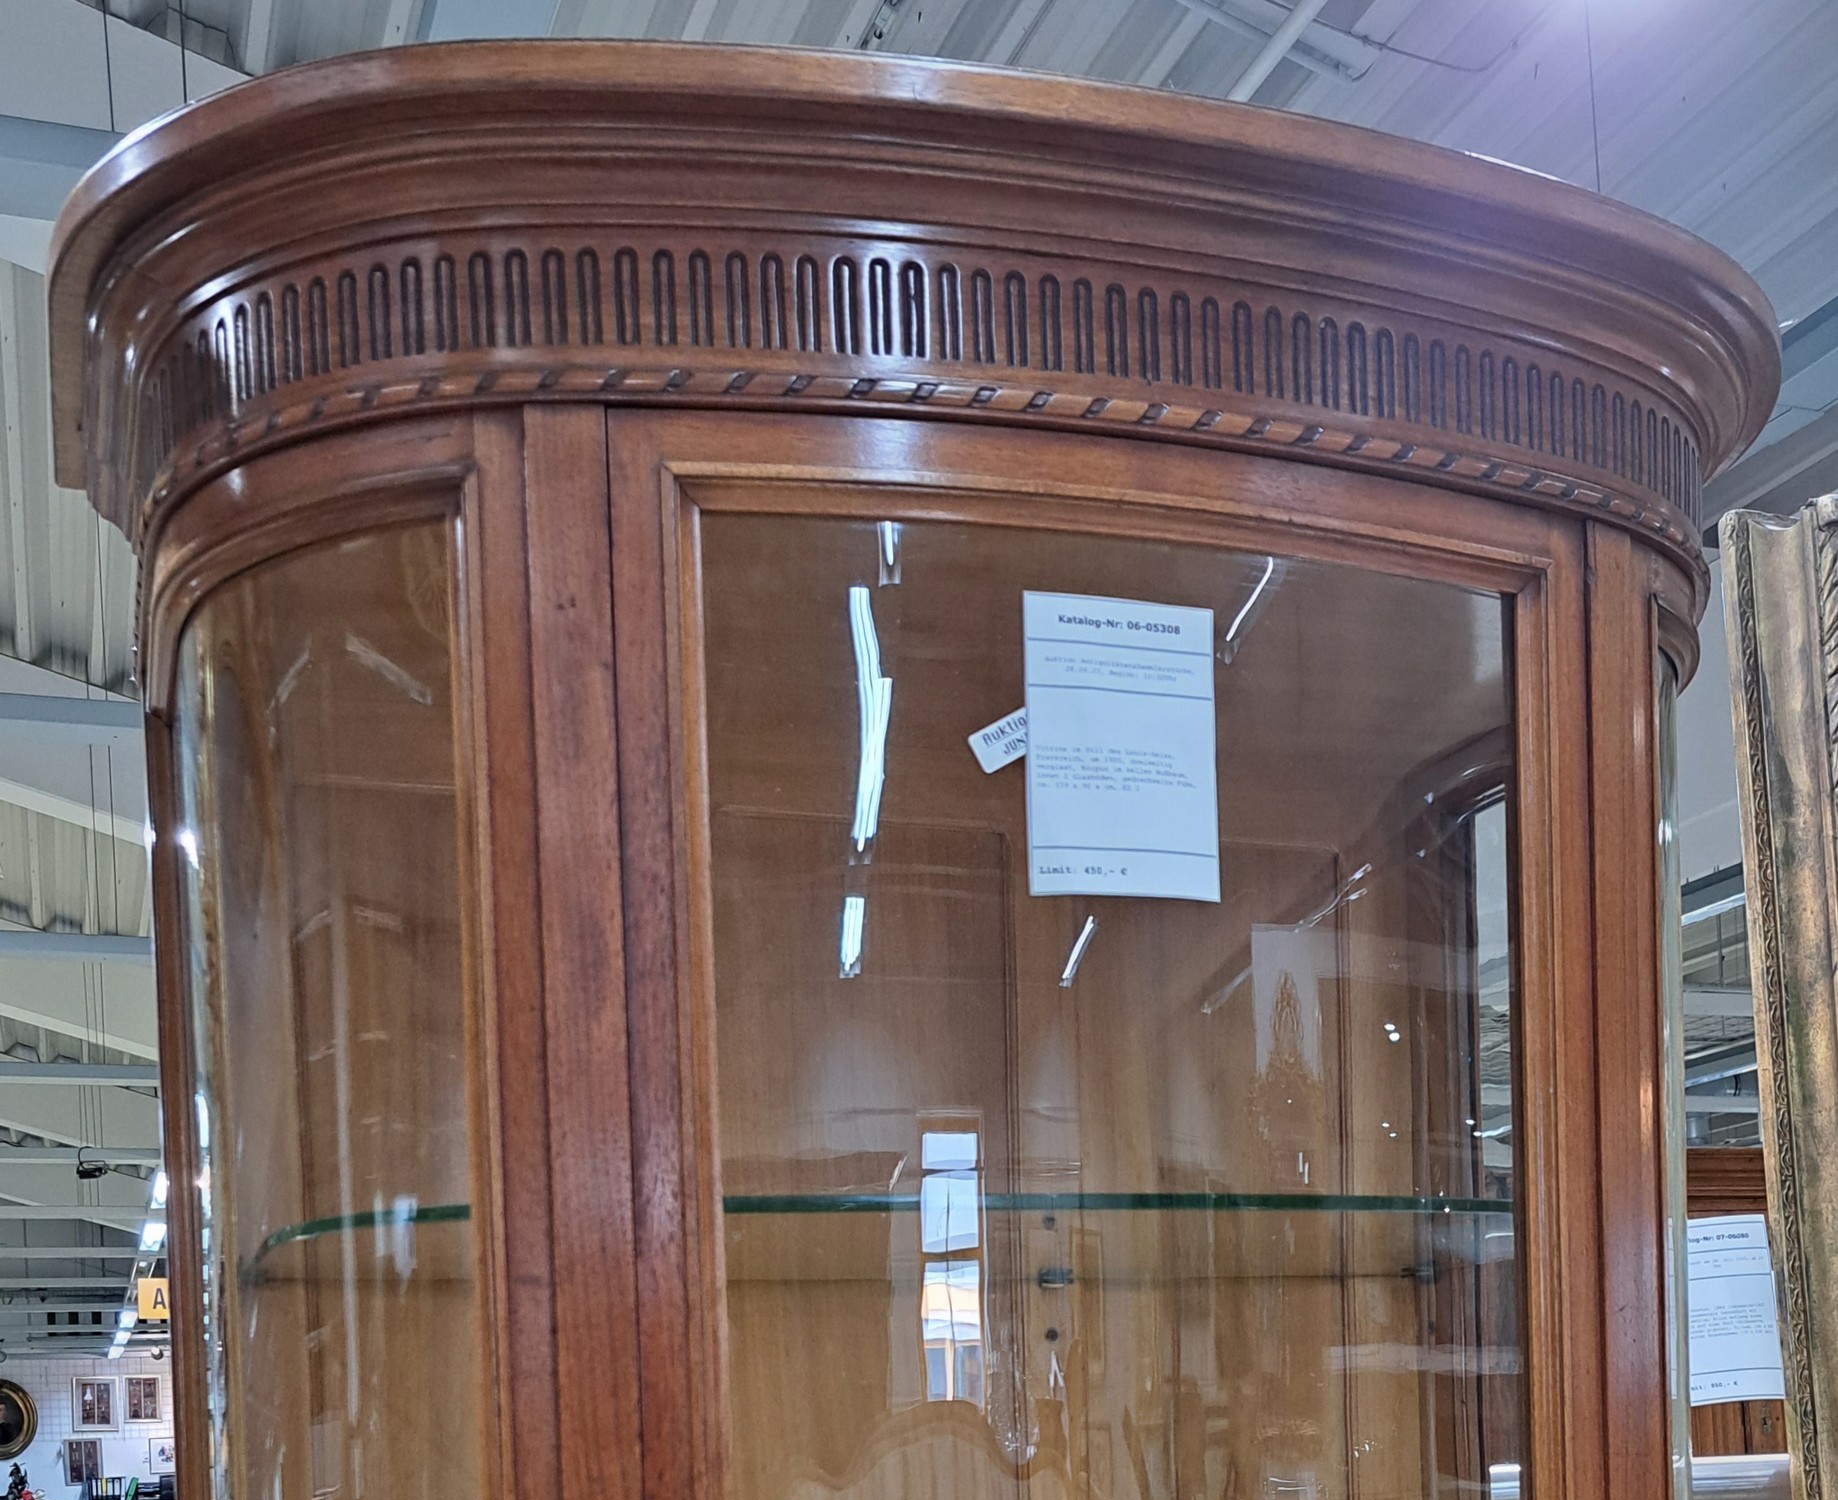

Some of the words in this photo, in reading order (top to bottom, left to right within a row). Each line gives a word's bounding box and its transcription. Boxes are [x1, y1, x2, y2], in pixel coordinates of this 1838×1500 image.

[1058, 614, 1123, 629] Katalog-Nr:
[1127, 620, 1181, 635] 06-05308
[982, 715, 1027, 747] Auktio
[1003, 732, 1027, 755] JUN
[153, 1287, 167, 1310] A
